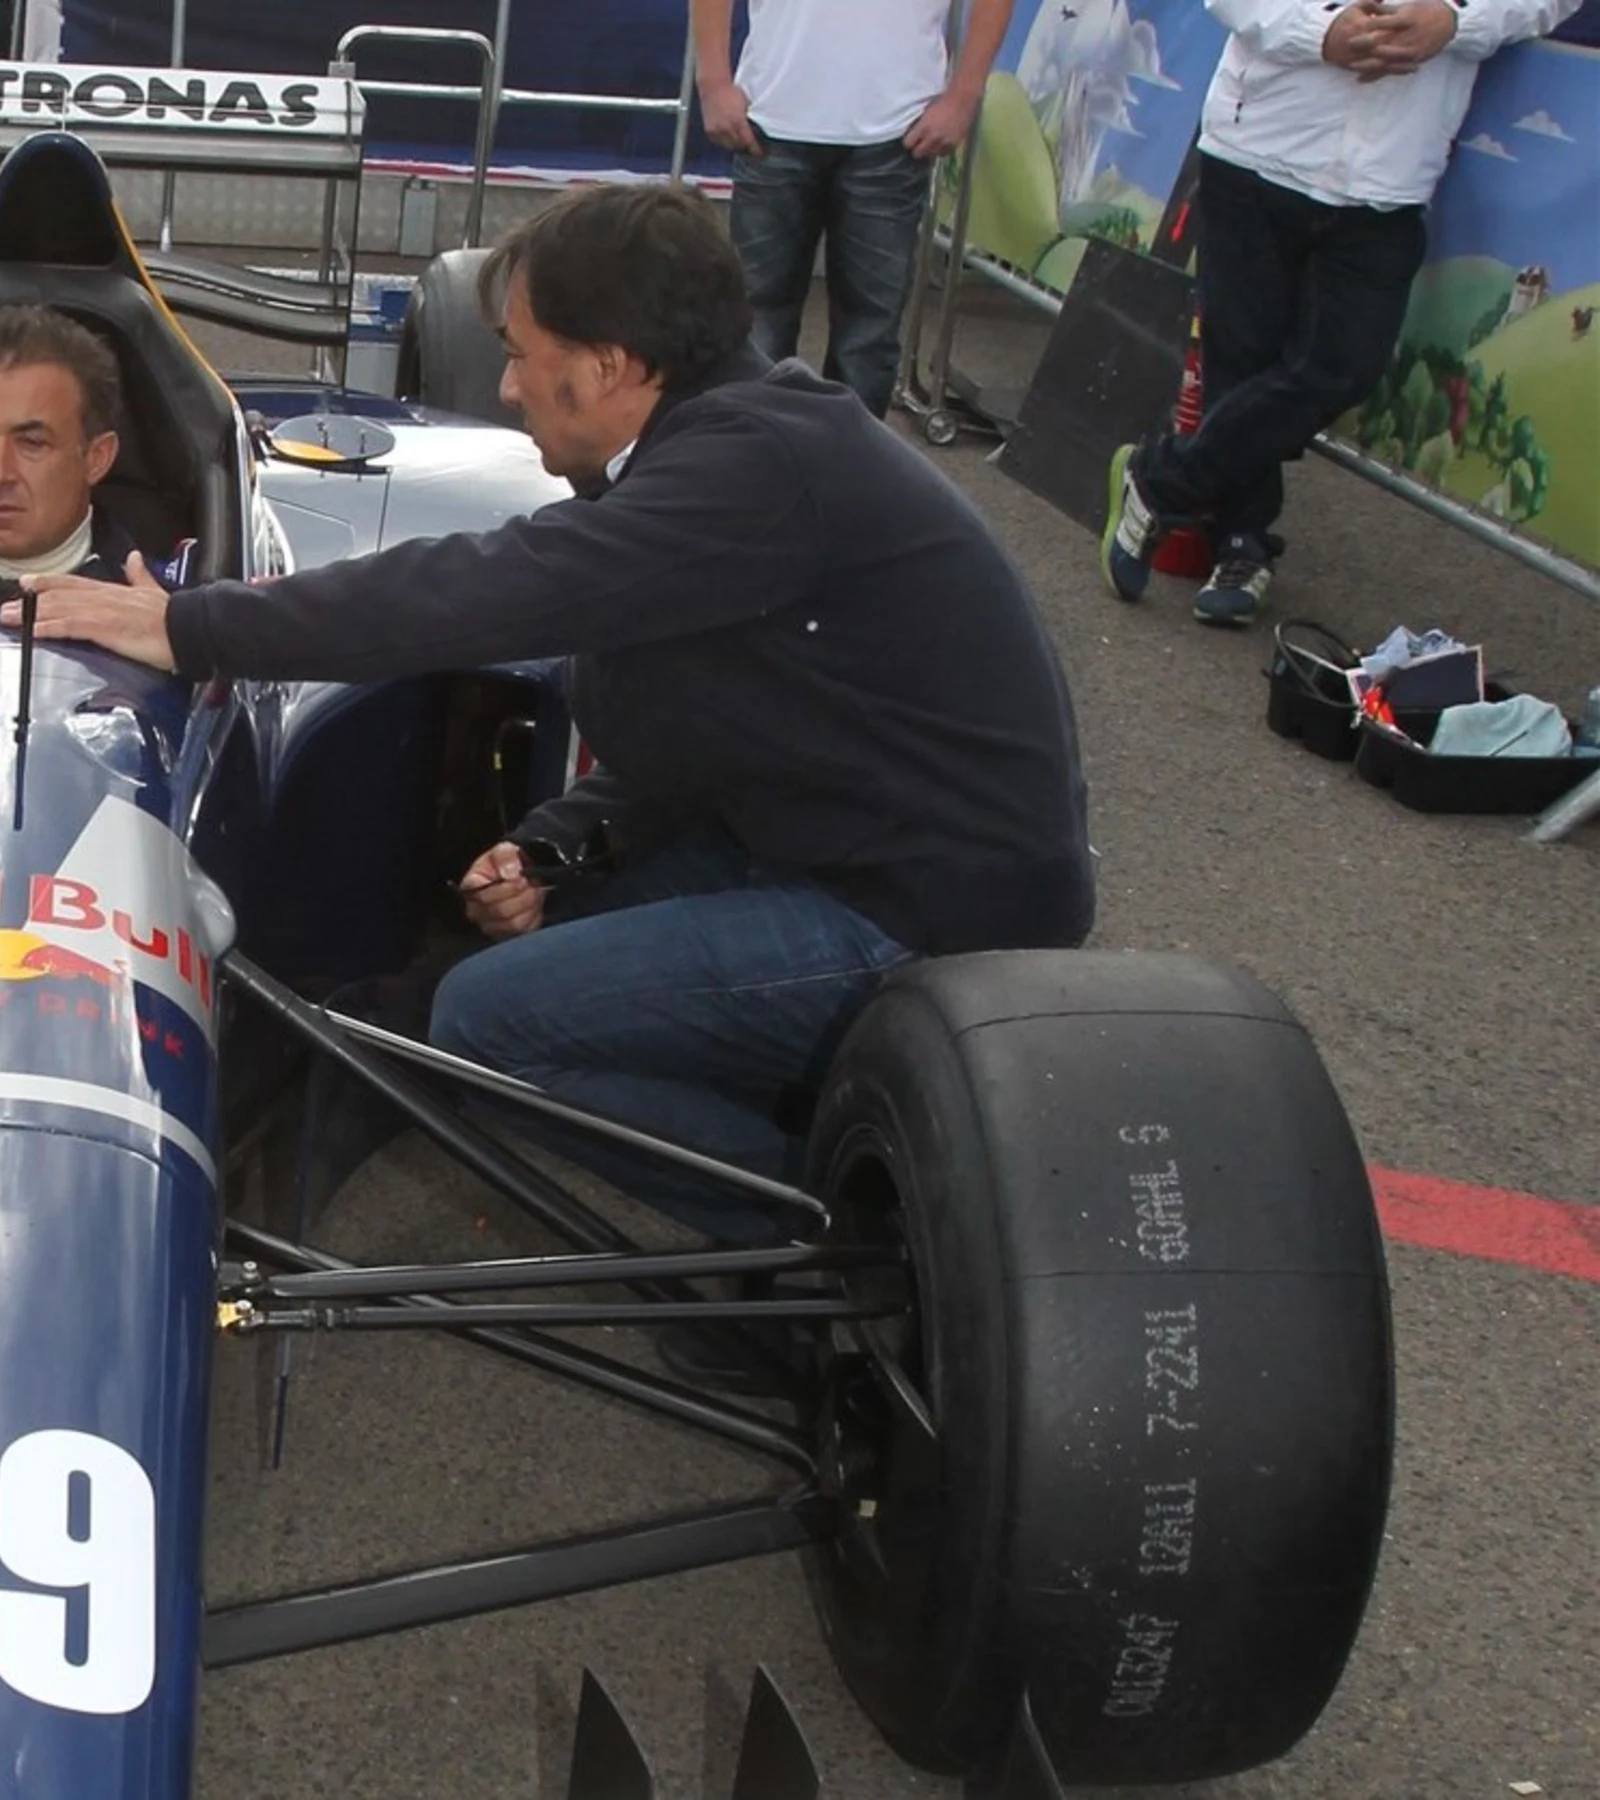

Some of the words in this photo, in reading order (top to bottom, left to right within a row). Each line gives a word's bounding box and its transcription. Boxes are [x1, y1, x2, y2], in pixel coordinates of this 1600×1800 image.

[29, 873, 211, 1008] Bull
[38, 995, 186, 1058] DRINK
[1144, 1302, 1200, 1437] 7-2241
